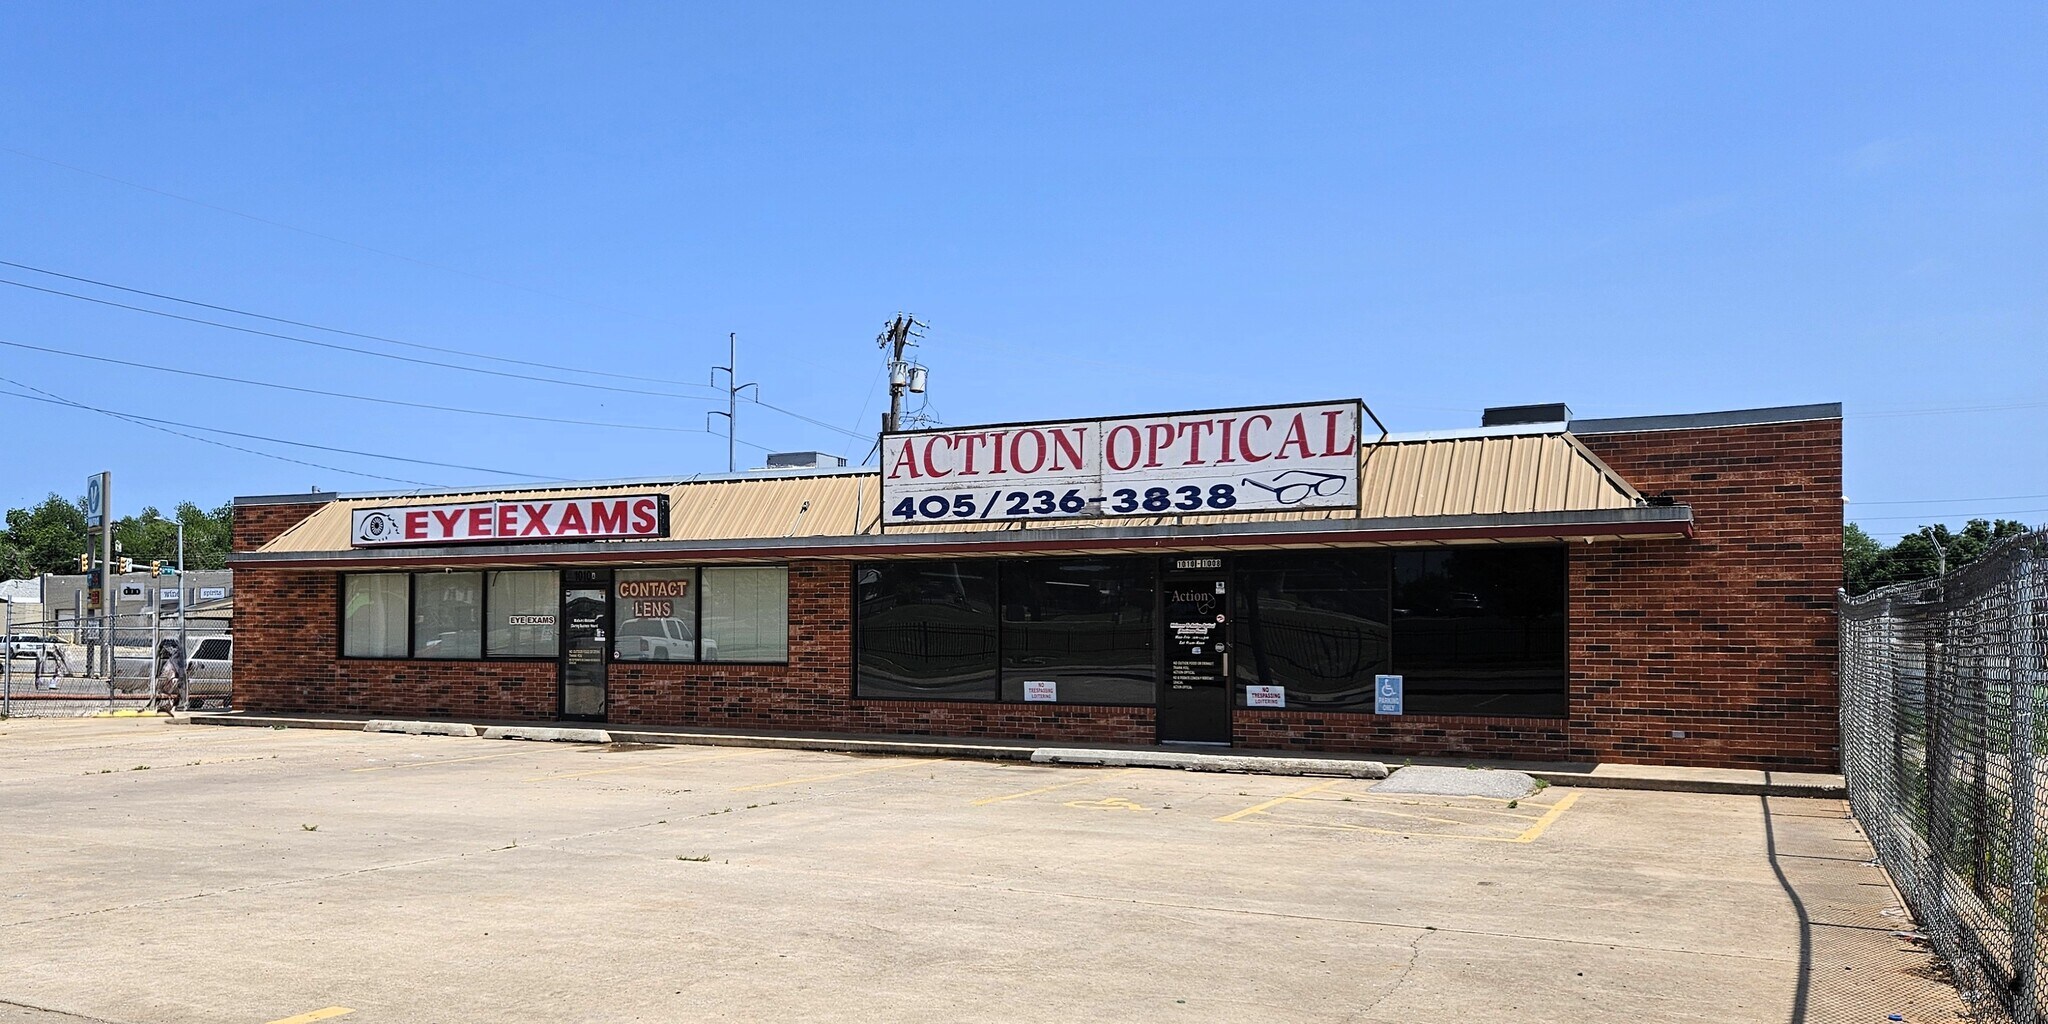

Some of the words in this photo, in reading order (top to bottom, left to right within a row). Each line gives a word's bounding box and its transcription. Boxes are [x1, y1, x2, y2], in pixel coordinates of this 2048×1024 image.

[888, 427, 1088, 479] ACTION
[1105, 409, 1356, 471] OPTICAL
[892, 483, 1237, 519] 405/236-3838
[405, 507, 492, 539] EYE
[497, 499, 657, 537] EXAMS
[203, 588, 222, 598] spirits
[619, 581, 687, 597] CONTACT
[1172, 590, 1208, 602] Action
[634, 602, 671, 617] LENS
[510, 616, 526, 624] EYE
[528, 616, 555, 624] EXAMS
